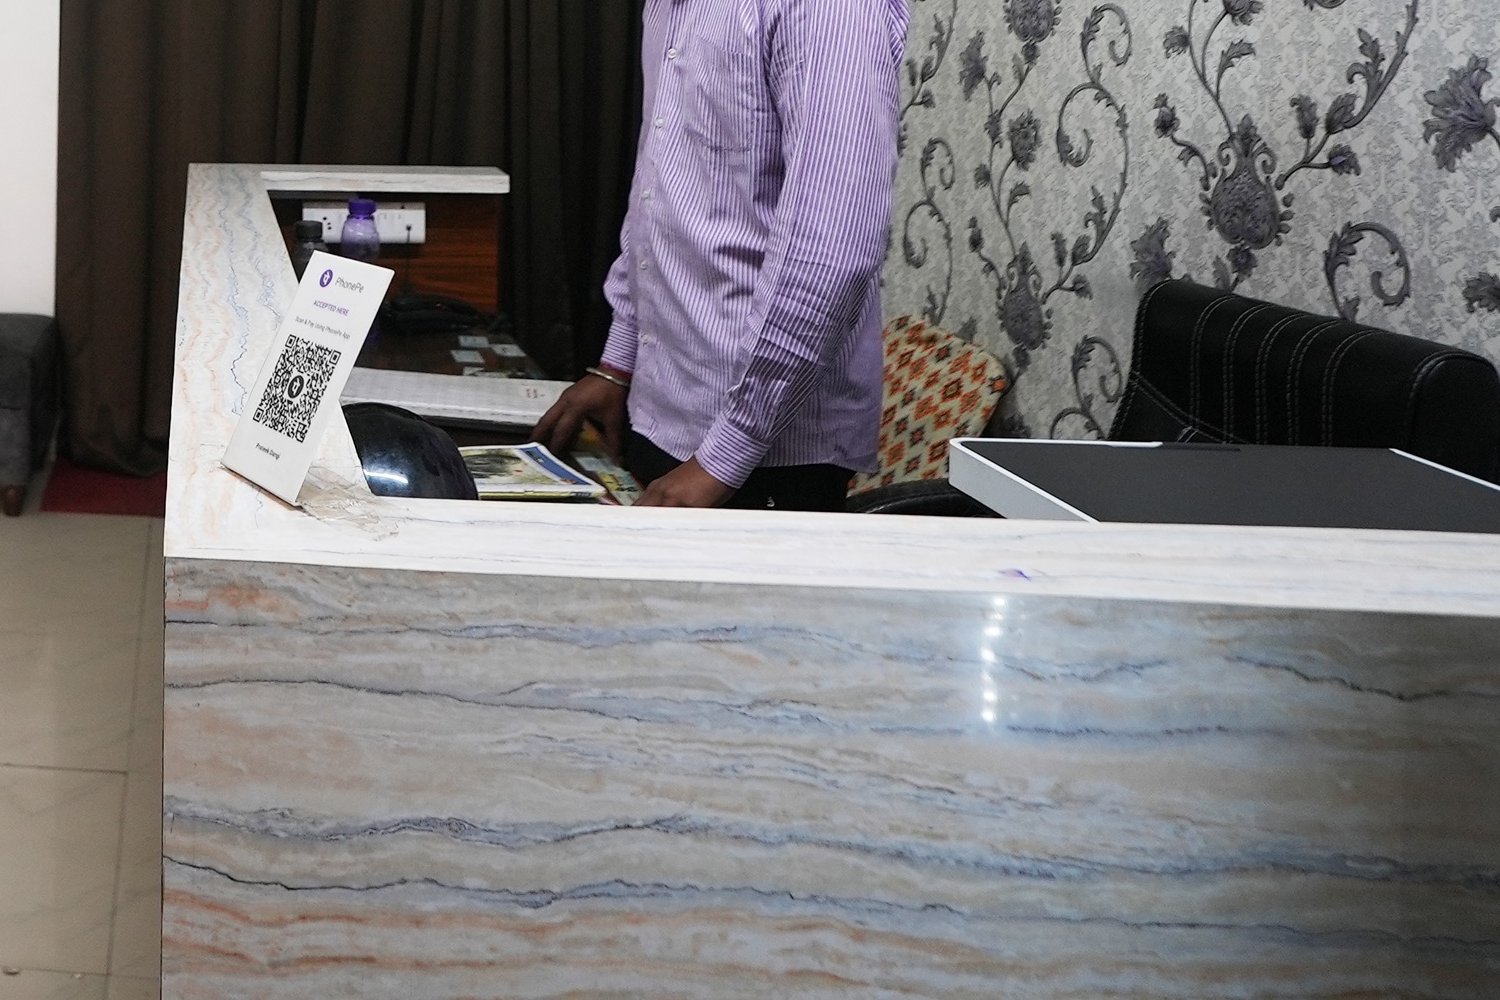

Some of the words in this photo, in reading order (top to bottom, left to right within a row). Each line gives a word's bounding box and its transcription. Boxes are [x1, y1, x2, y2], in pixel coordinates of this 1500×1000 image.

[334, 276, 365, 293] PhonePe
[313, 299, 337, 312] ACCEPTED
[336, 307, 350, 316] HERE
